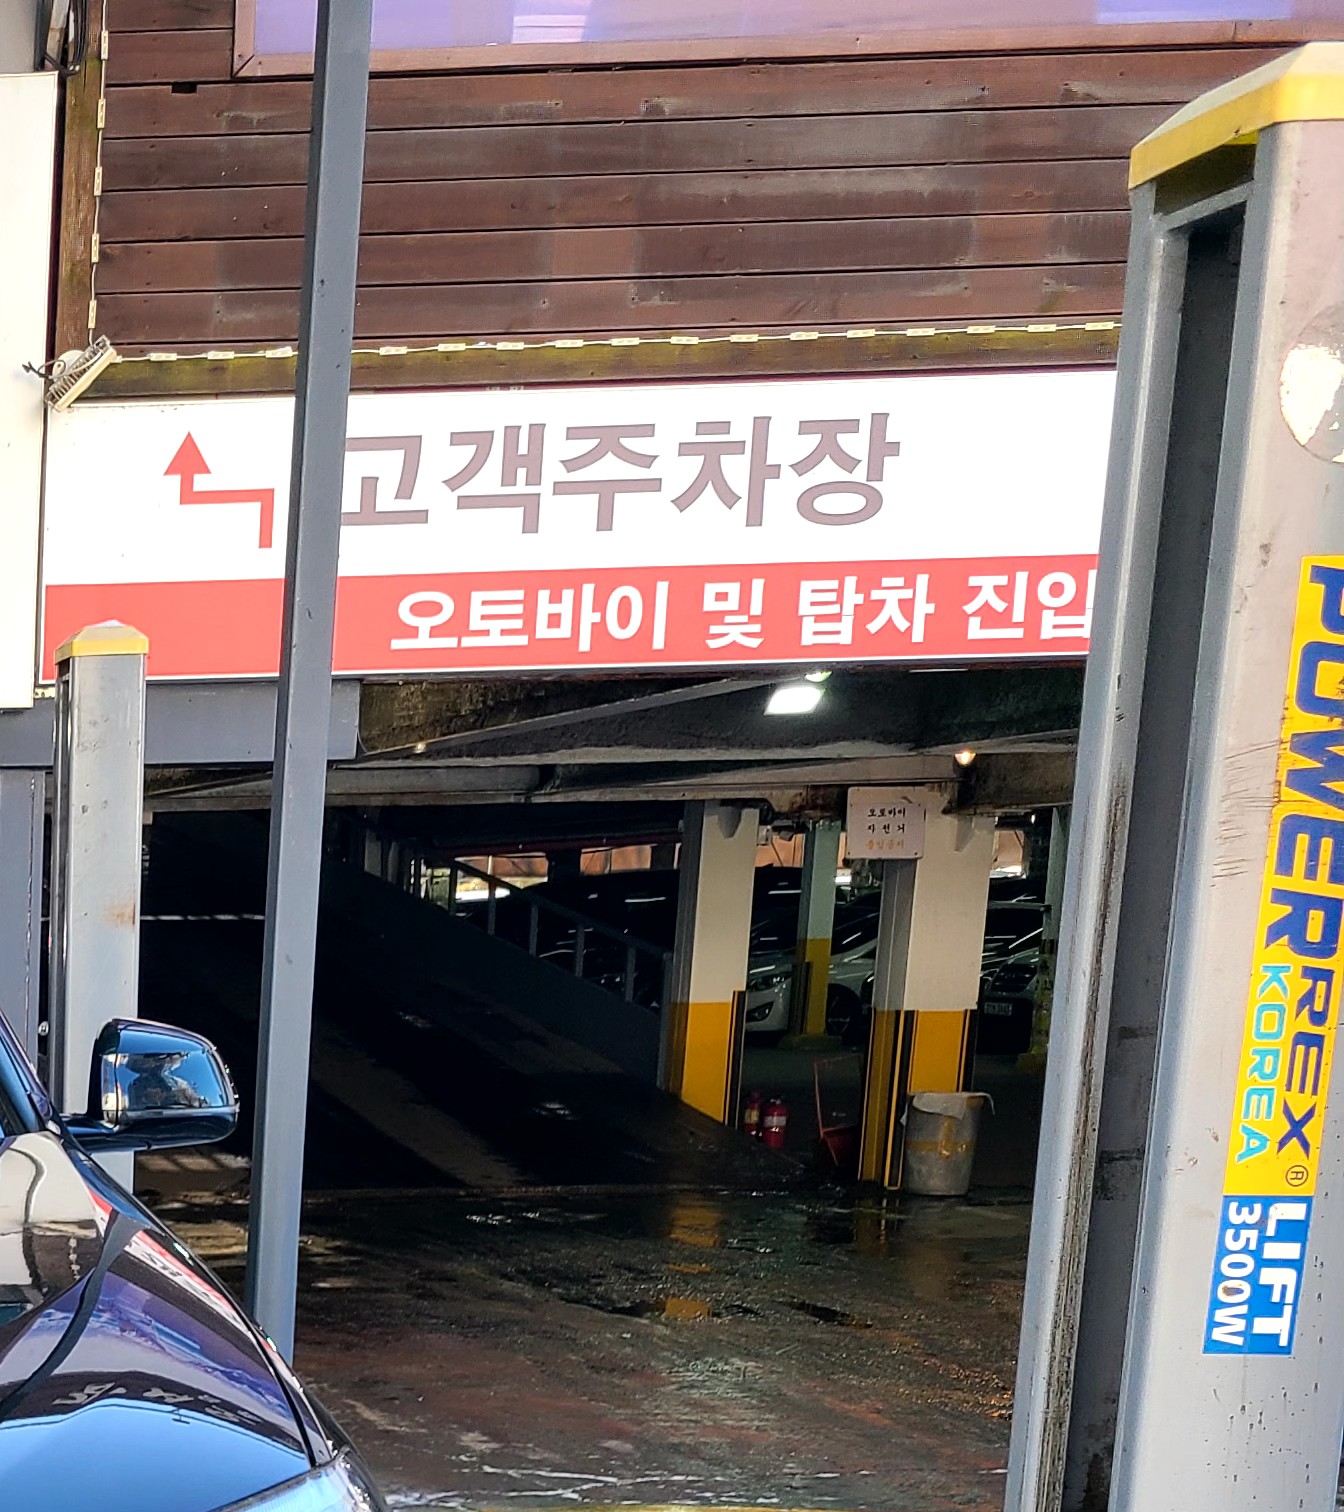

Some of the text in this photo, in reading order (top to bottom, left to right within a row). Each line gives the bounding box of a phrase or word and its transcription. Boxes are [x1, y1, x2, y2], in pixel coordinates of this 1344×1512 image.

[341, 411, 902, 534] 고객주차장
[389, 568, 1098, 652] 오토바이 및 탑차 진입
[1235, 962, 1289, 1165] KOREA
[1211, 1201, 1263, 1346] 3500W
[1251, 1202, 1308, 1348] LIFT
